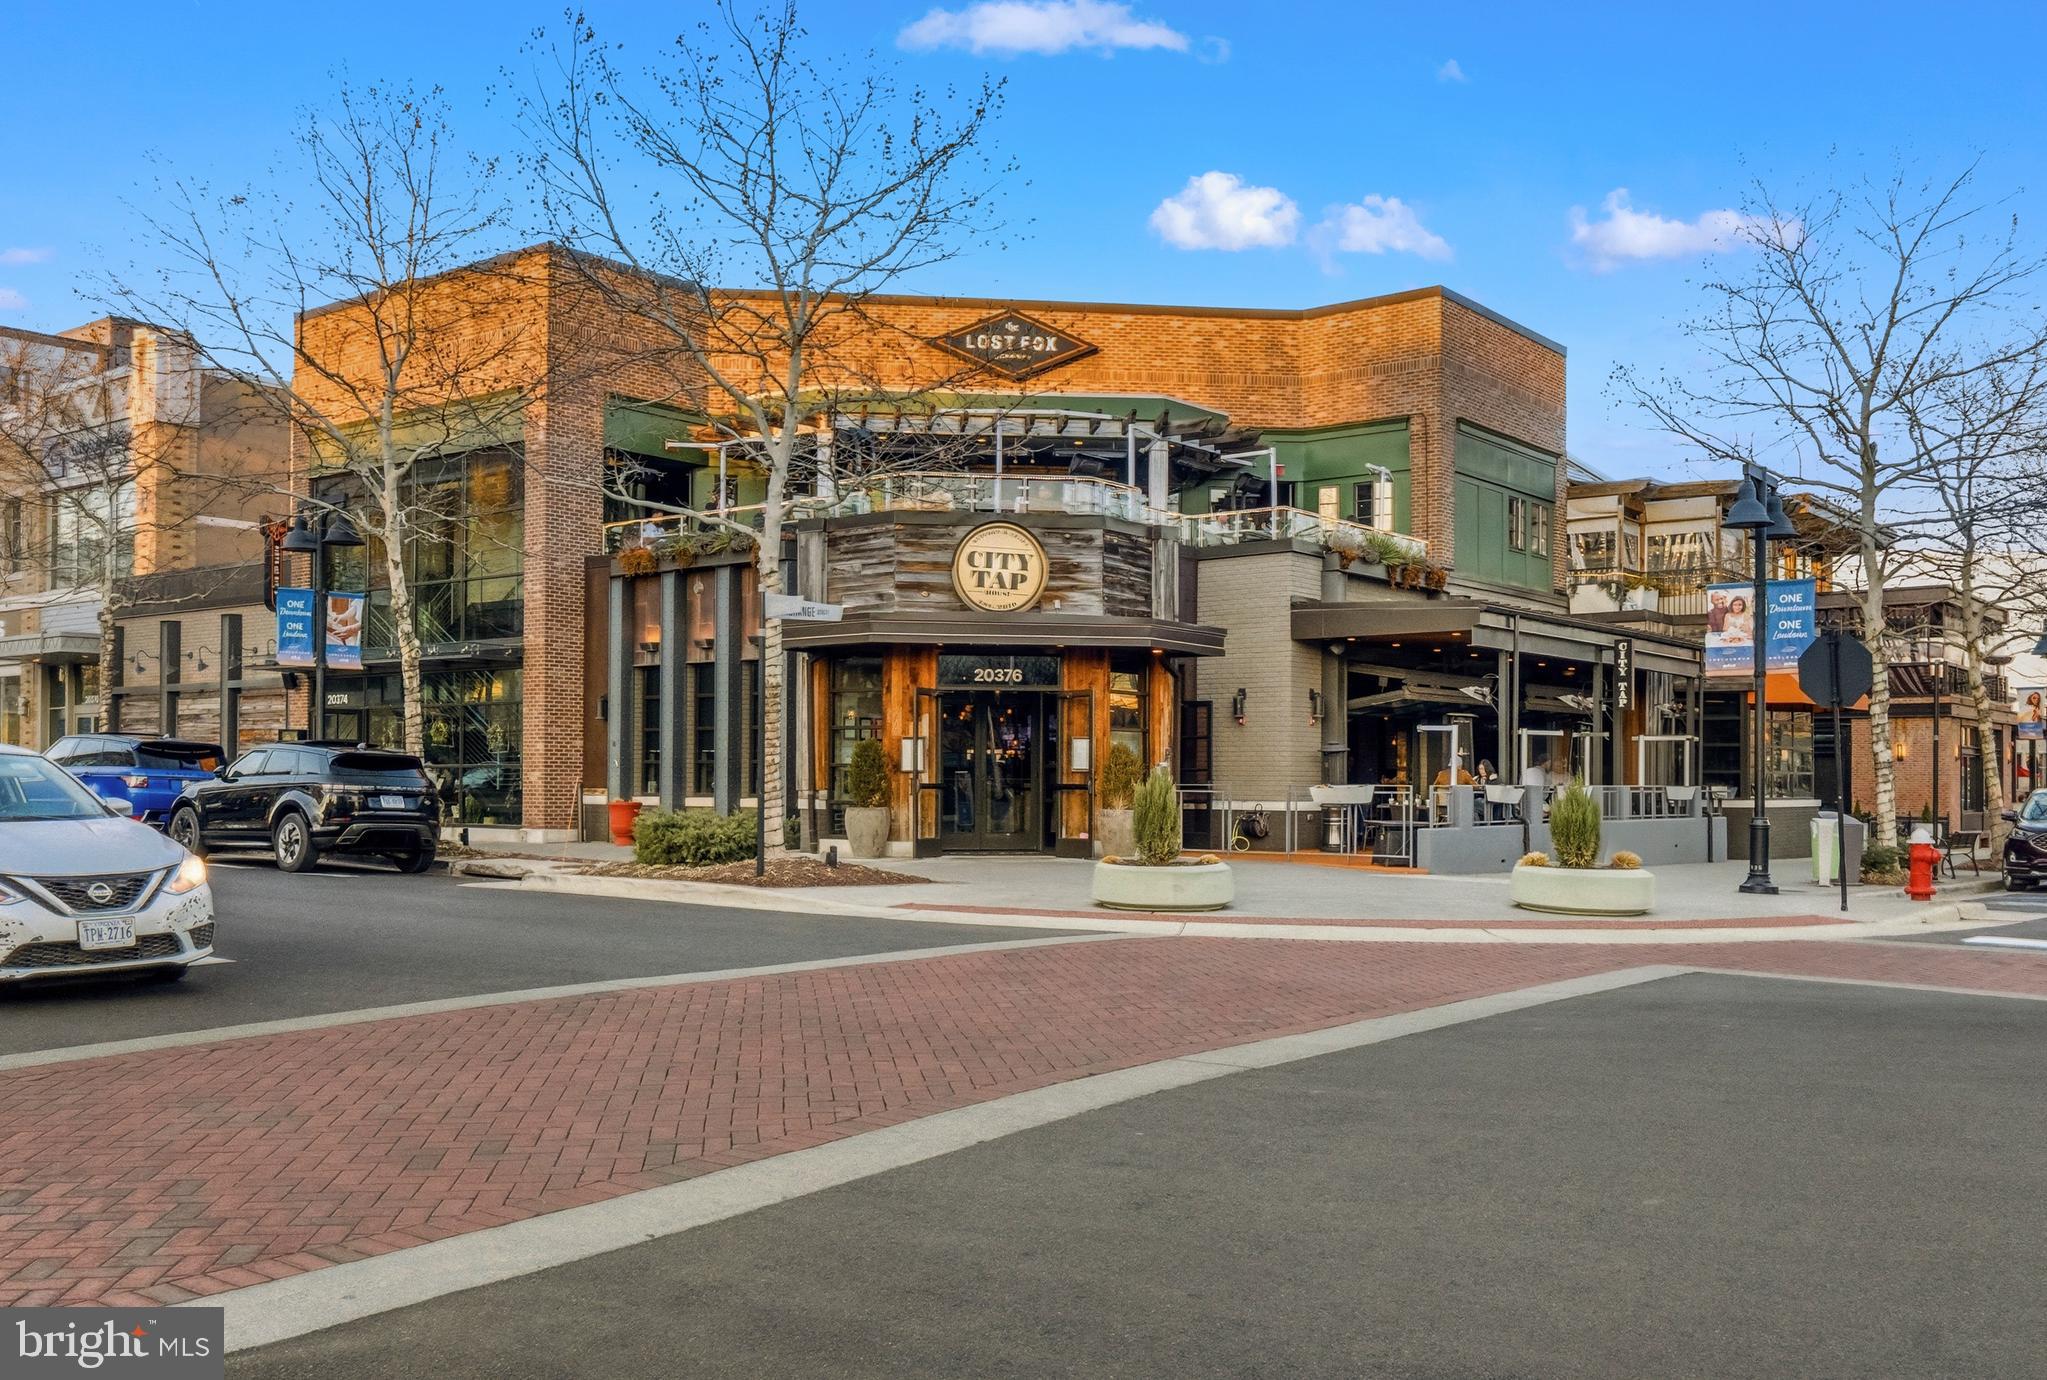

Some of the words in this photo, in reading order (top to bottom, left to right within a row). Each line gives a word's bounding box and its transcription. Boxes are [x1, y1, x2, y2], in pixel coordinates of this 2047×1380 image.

[966, 334, 1016, 350] LOST
[1020, 335, 1058, 351] FOX
[967, 550, 1034, 571] CITY
[971, 570, 1028, 590] TAP
[286, 600, 305, 609] ONE
[1779, 593, 1803, 603] ONE
[286, 622, 304, 631] ONE
[1778, 620, 1802, 629] ONE
[1618, 642, 1628, 676] CITY
[974, 668, 1023, 682] 20376
[327, 694, 348, 705] 20374
[1618, 682, 1628, 708] TAP
